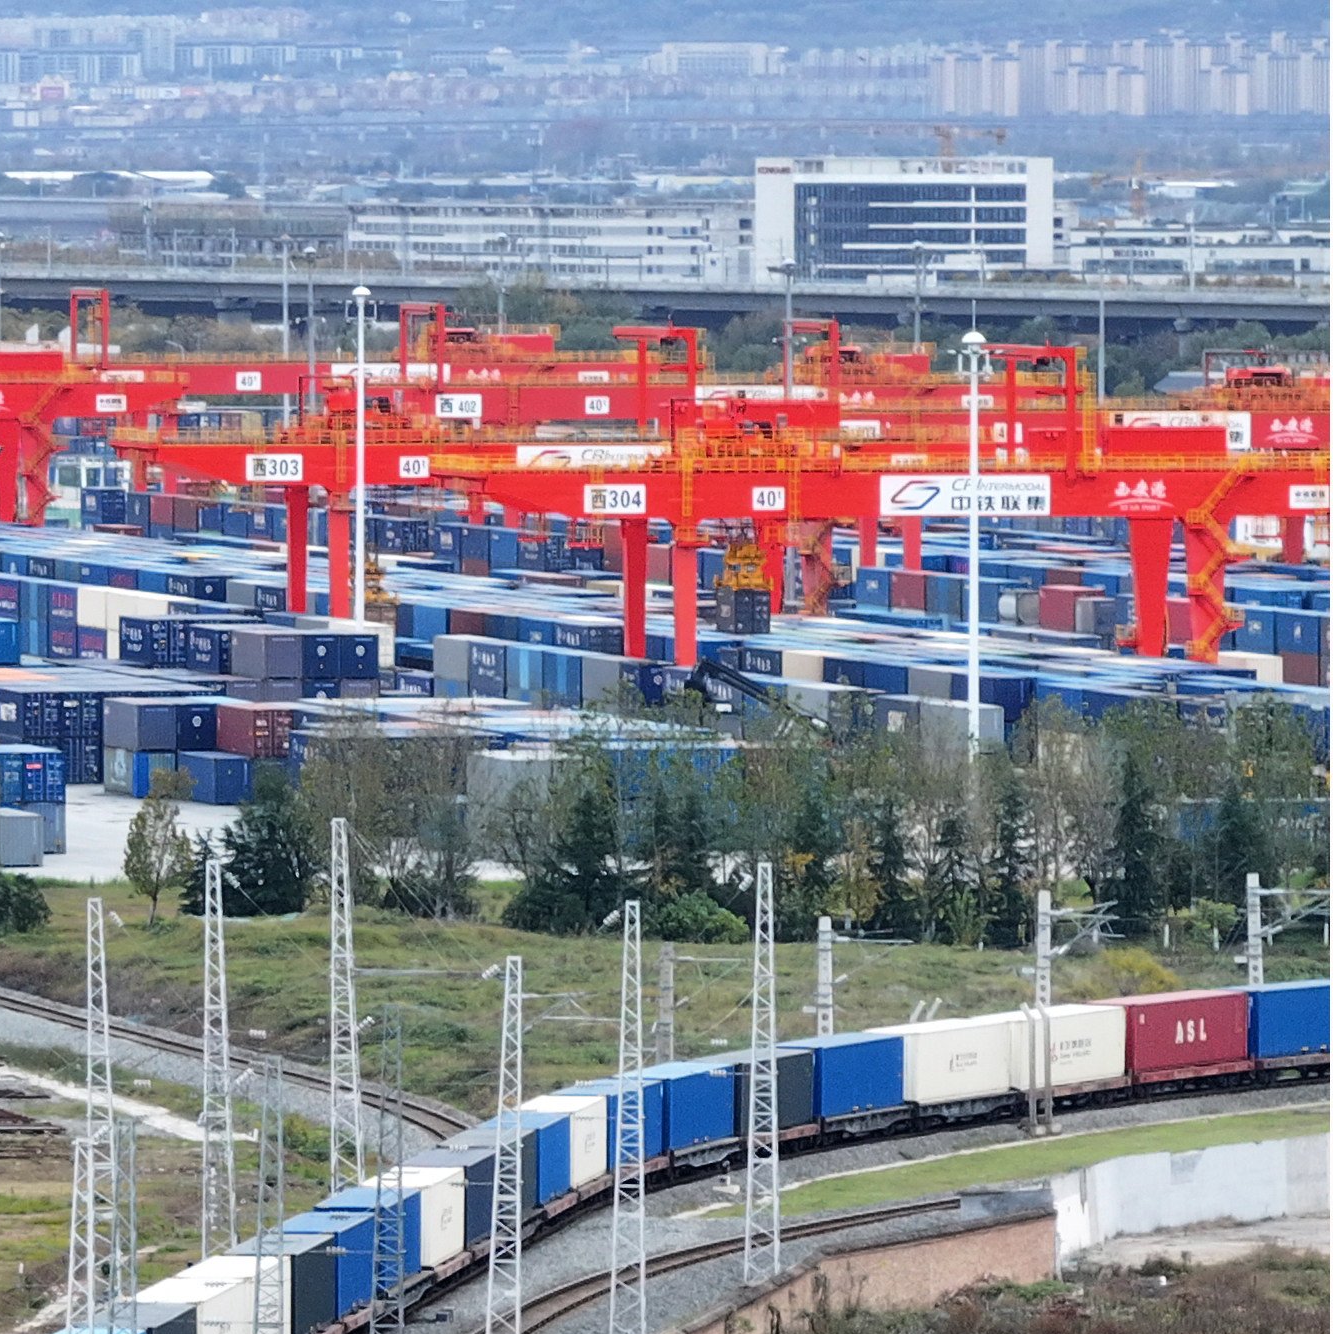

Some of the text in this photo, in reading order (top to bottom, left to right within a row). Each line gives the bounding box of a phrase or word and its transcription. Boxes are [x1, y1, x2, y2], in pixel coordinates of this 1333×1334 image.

[951, 495, 1046, 511] 中铁联集
[1175, 1018, 1207, 1044] ASL
